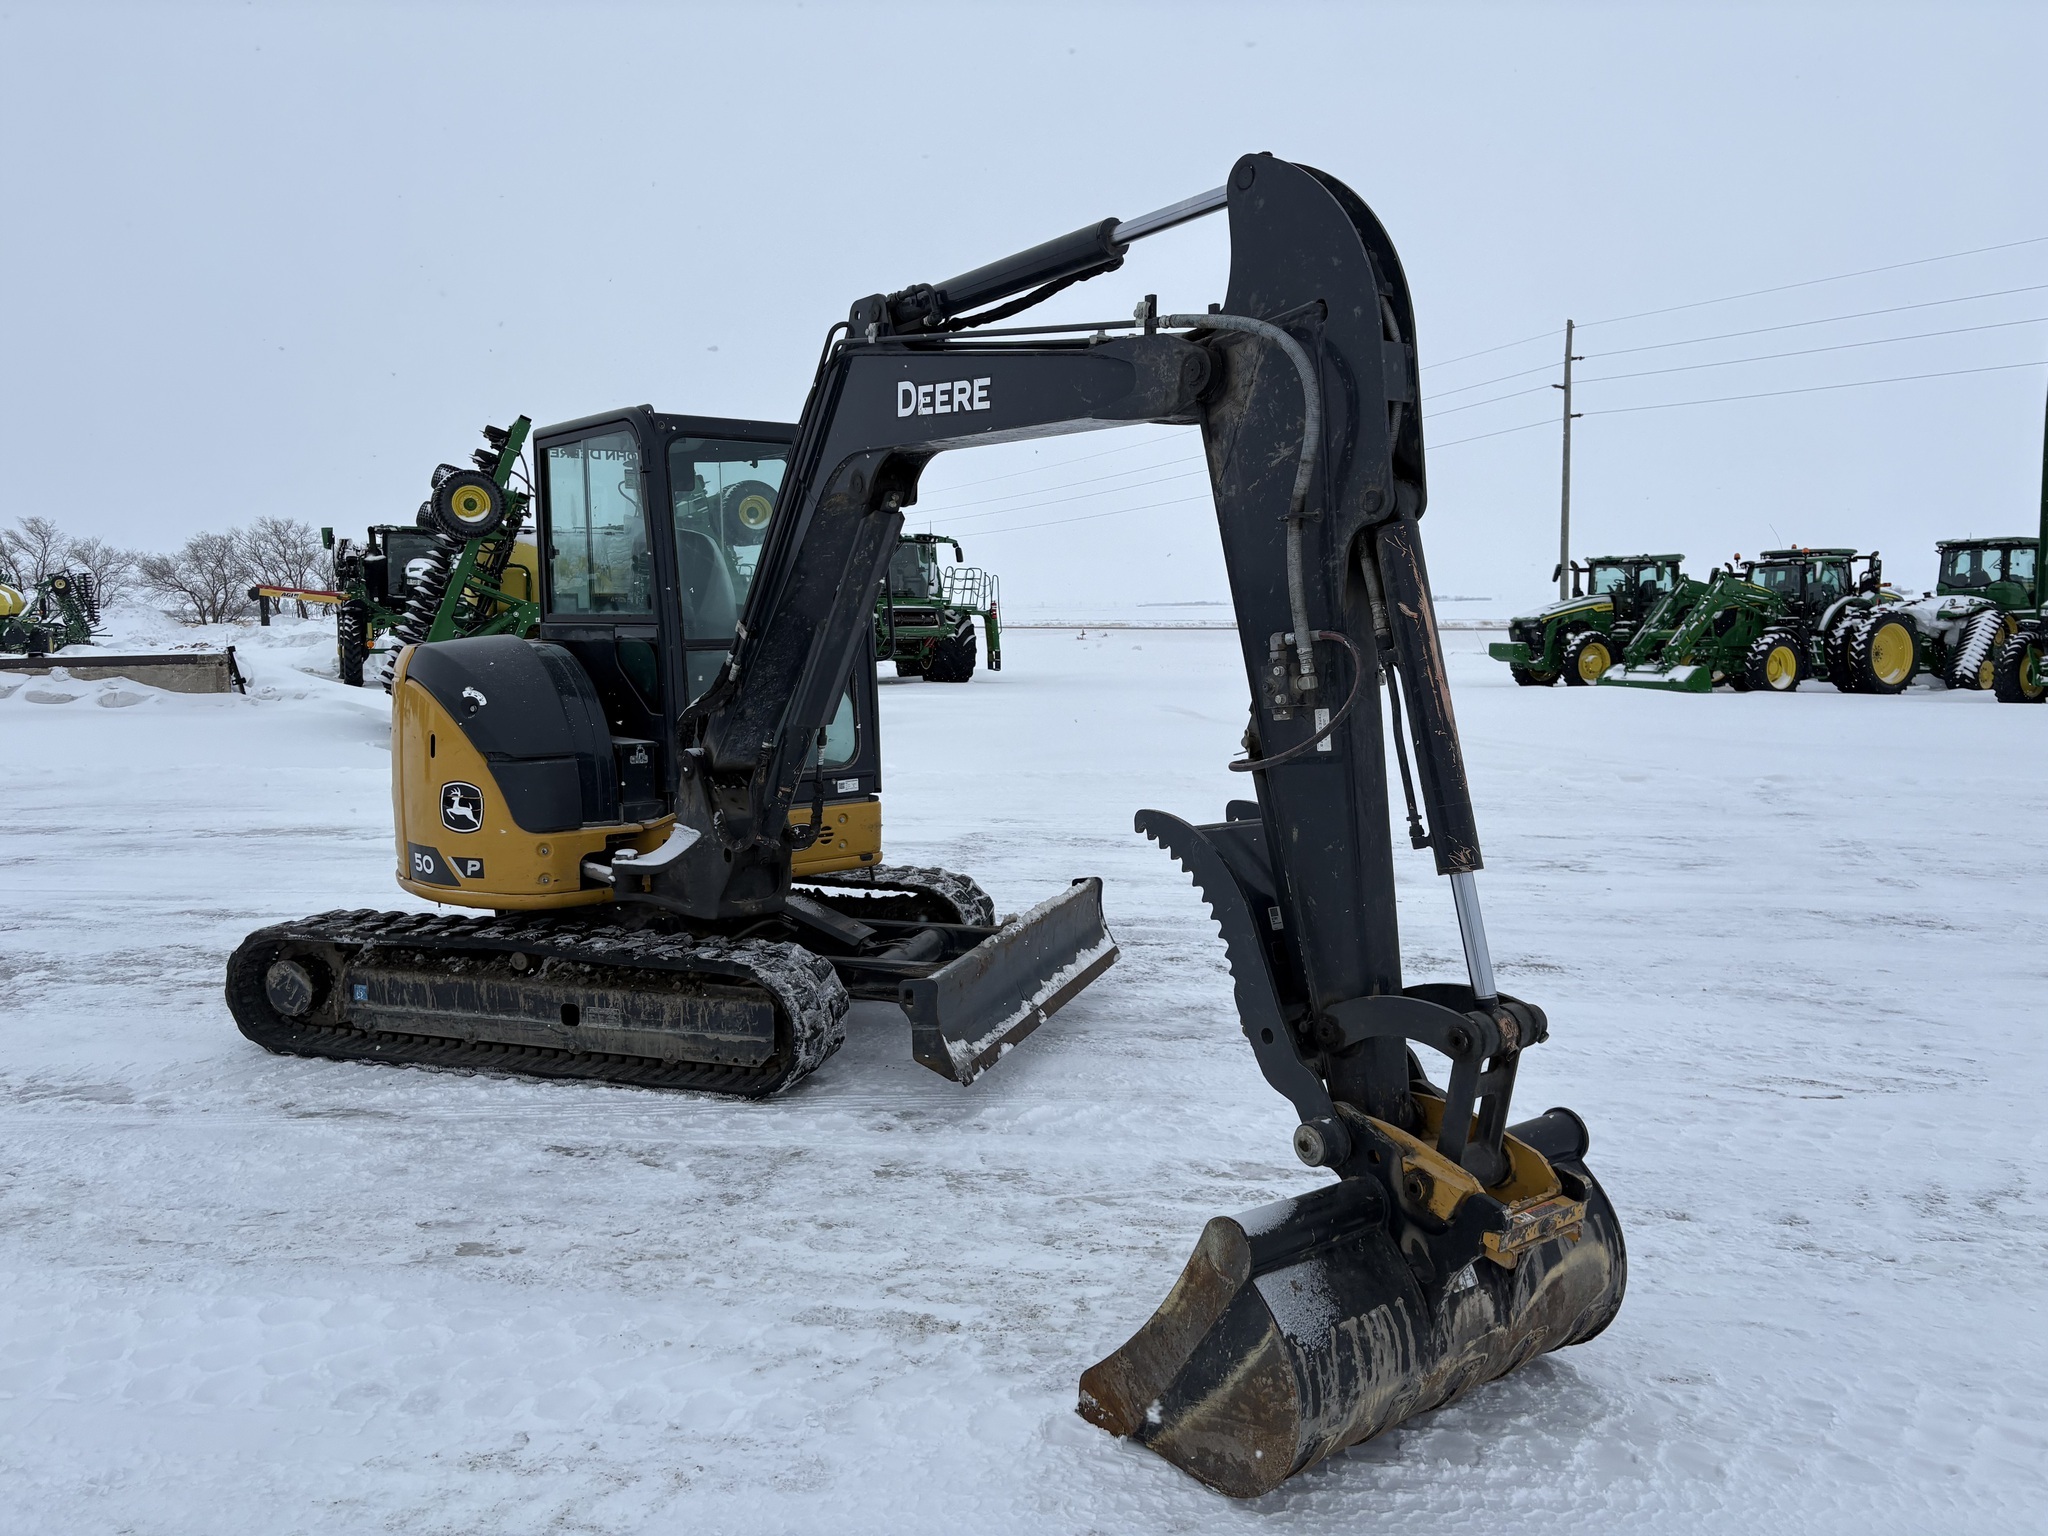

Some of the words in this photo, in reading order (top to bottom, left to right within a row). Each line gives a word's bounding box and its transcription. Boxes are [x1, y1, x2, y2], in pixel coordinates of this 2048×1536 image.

[897, 377, 991, 418] DEERE
[414, 852, 435, 875] 50
[466, 860, 481, 876] P
